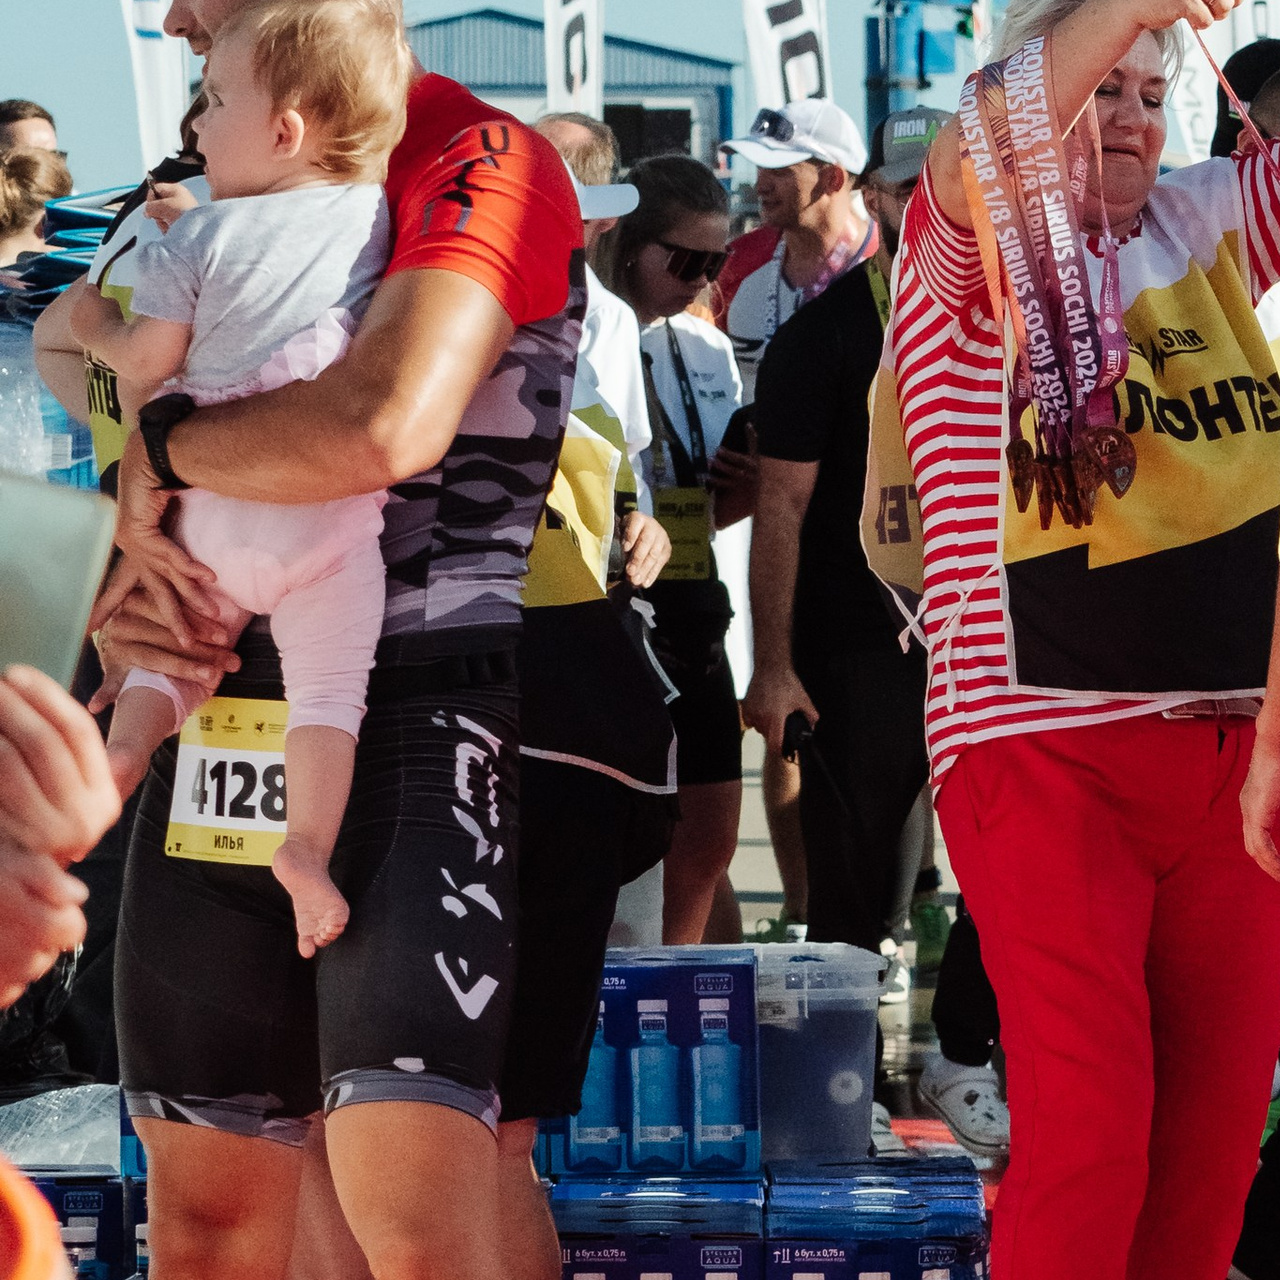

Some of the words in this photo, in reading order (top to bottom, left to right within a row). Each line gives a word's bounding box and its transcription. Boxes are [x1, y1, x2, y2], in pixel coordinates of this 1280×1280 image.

[1023, 35, 1052, 145] IRONSTAR
[893, 118, 927, 138] IRON
[959, 79, 997, 184] IRONSTAR
[1034, 147, 1061, 186] 1/8
[982, 185, 1012, 225] 1/8
[1042, 189, 1076, 262] SIRIUS
[996, 226, 1035, 297] SIRIUS
[1057, 264, 1089, 334] SOCHI
[1020, 298, 1056, 367] SOCHI
[1106, 349, 1117, 370] STAR
[1158, 327, 1205, 350] STAR
[1071, 336, 1098, 394] 2024
[1043, 367, 1072, 422] 2024
[191, 758, 287, 822] 4128
[214, 834, 244, 851] ИЛЬЯ
[603, 1249, 619, 1258] 0,75
[822, 1248, 839, 1258] 0,75
